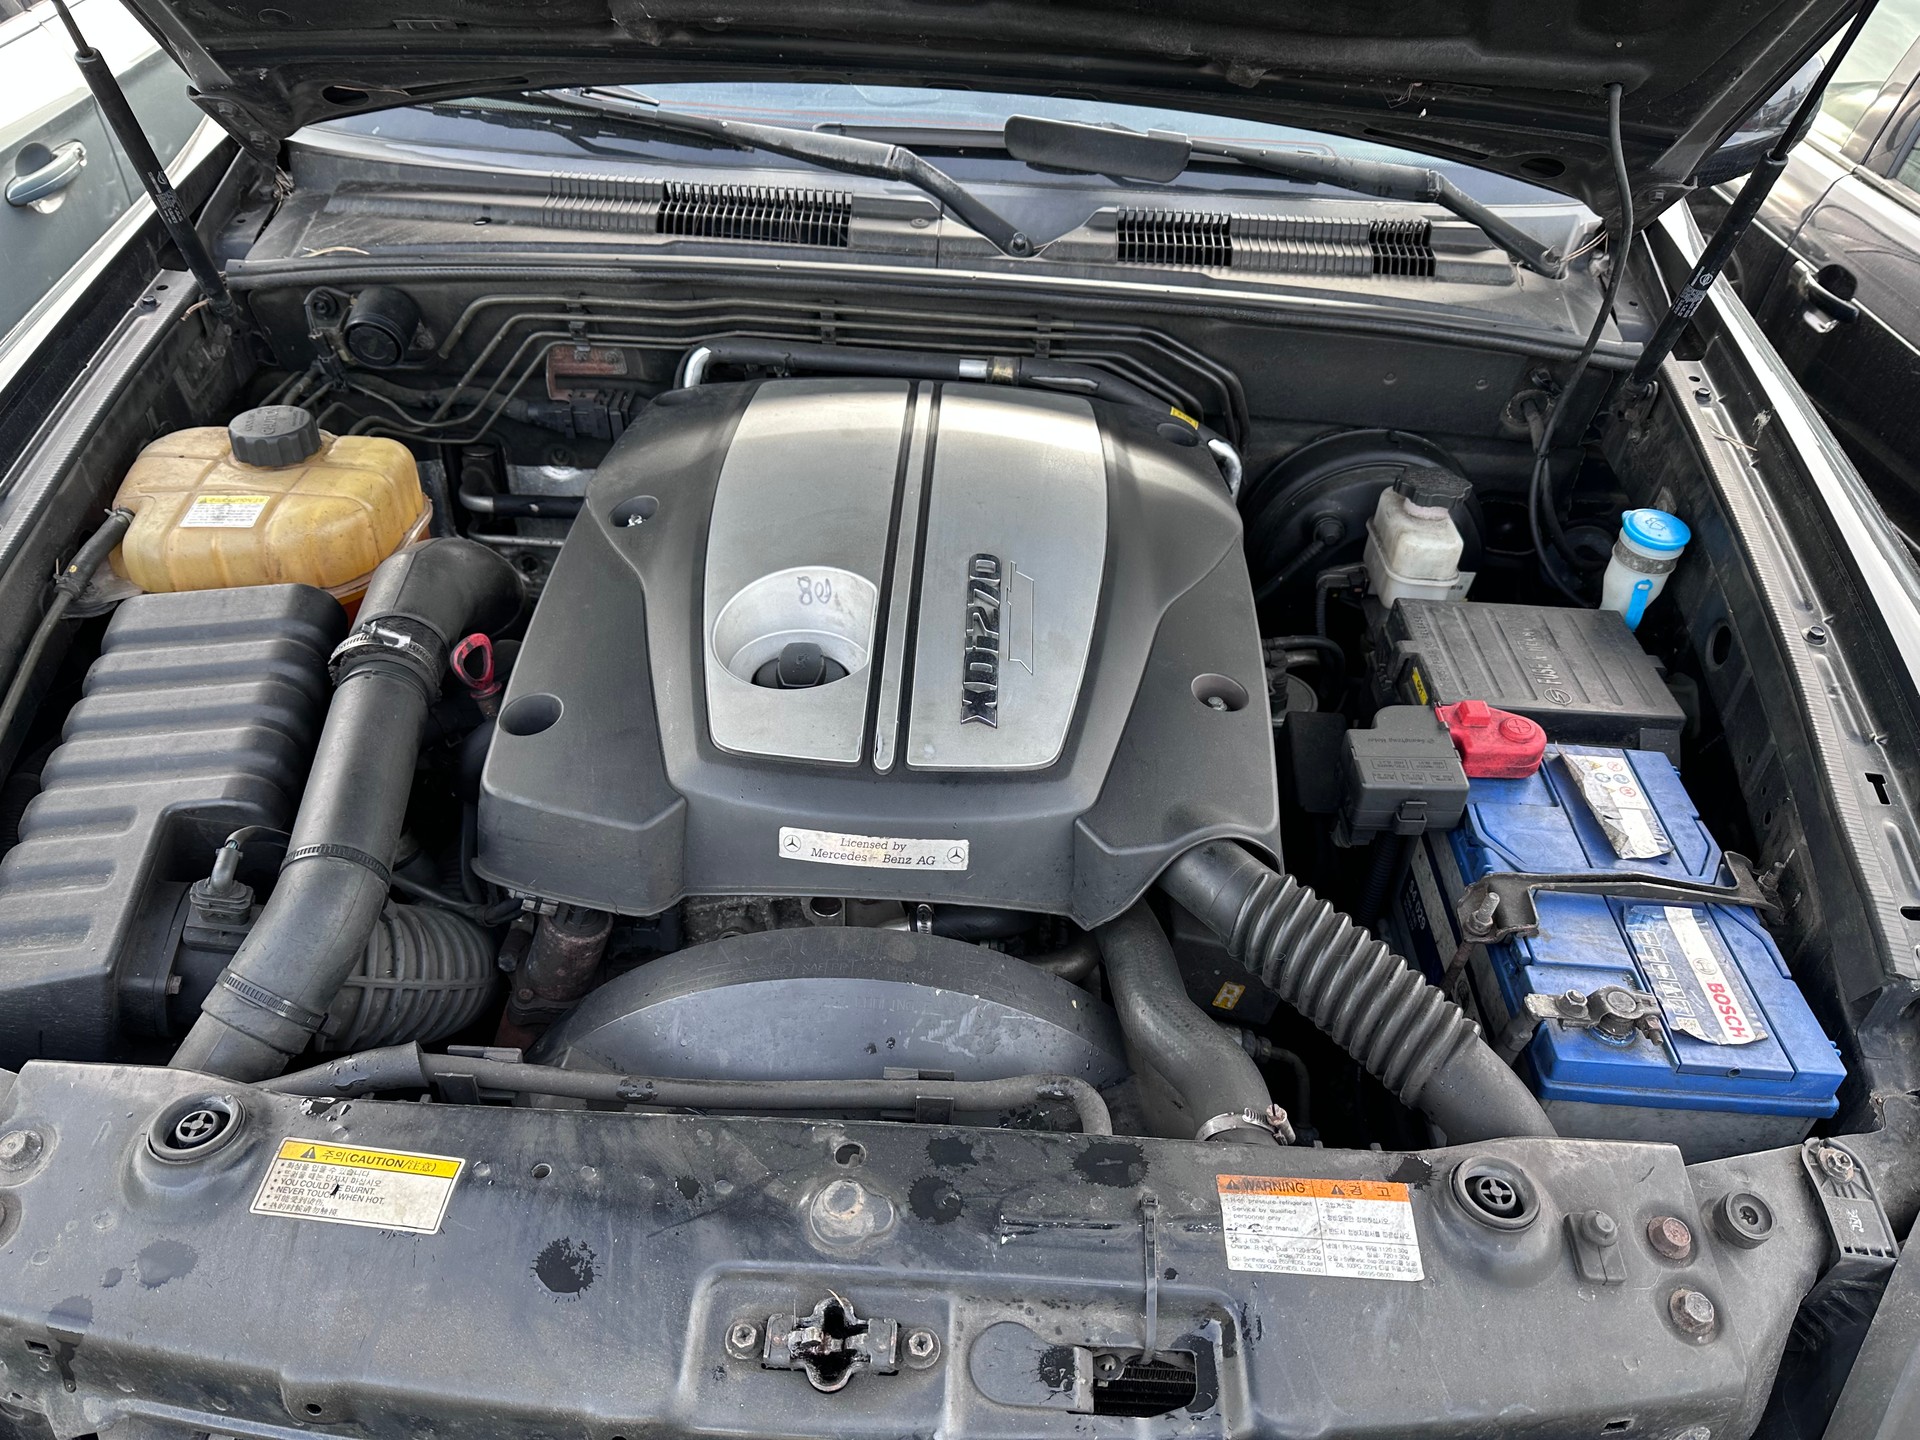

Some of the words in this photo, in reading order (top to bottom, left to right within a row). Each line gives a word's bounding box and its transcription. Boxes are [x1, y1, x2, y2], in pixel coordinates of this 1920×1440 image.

[839, 837, 889, 851] Licensed
[892, 841, 908, 852] by
[915, 855, 936, 866] AG
[1705, 981, 1749, 1040] BOSCH
[280, 1178, 297, 1186] YOU
[300, 1181, 328, 1190] COULD
[1242, 1179, 1305, 1193] WARNING
[1376, 1186, 1390, 1196] 고
[277, 1186, 303, 1195] NEVER
[338, 1194, 363, 1202] WHEN
